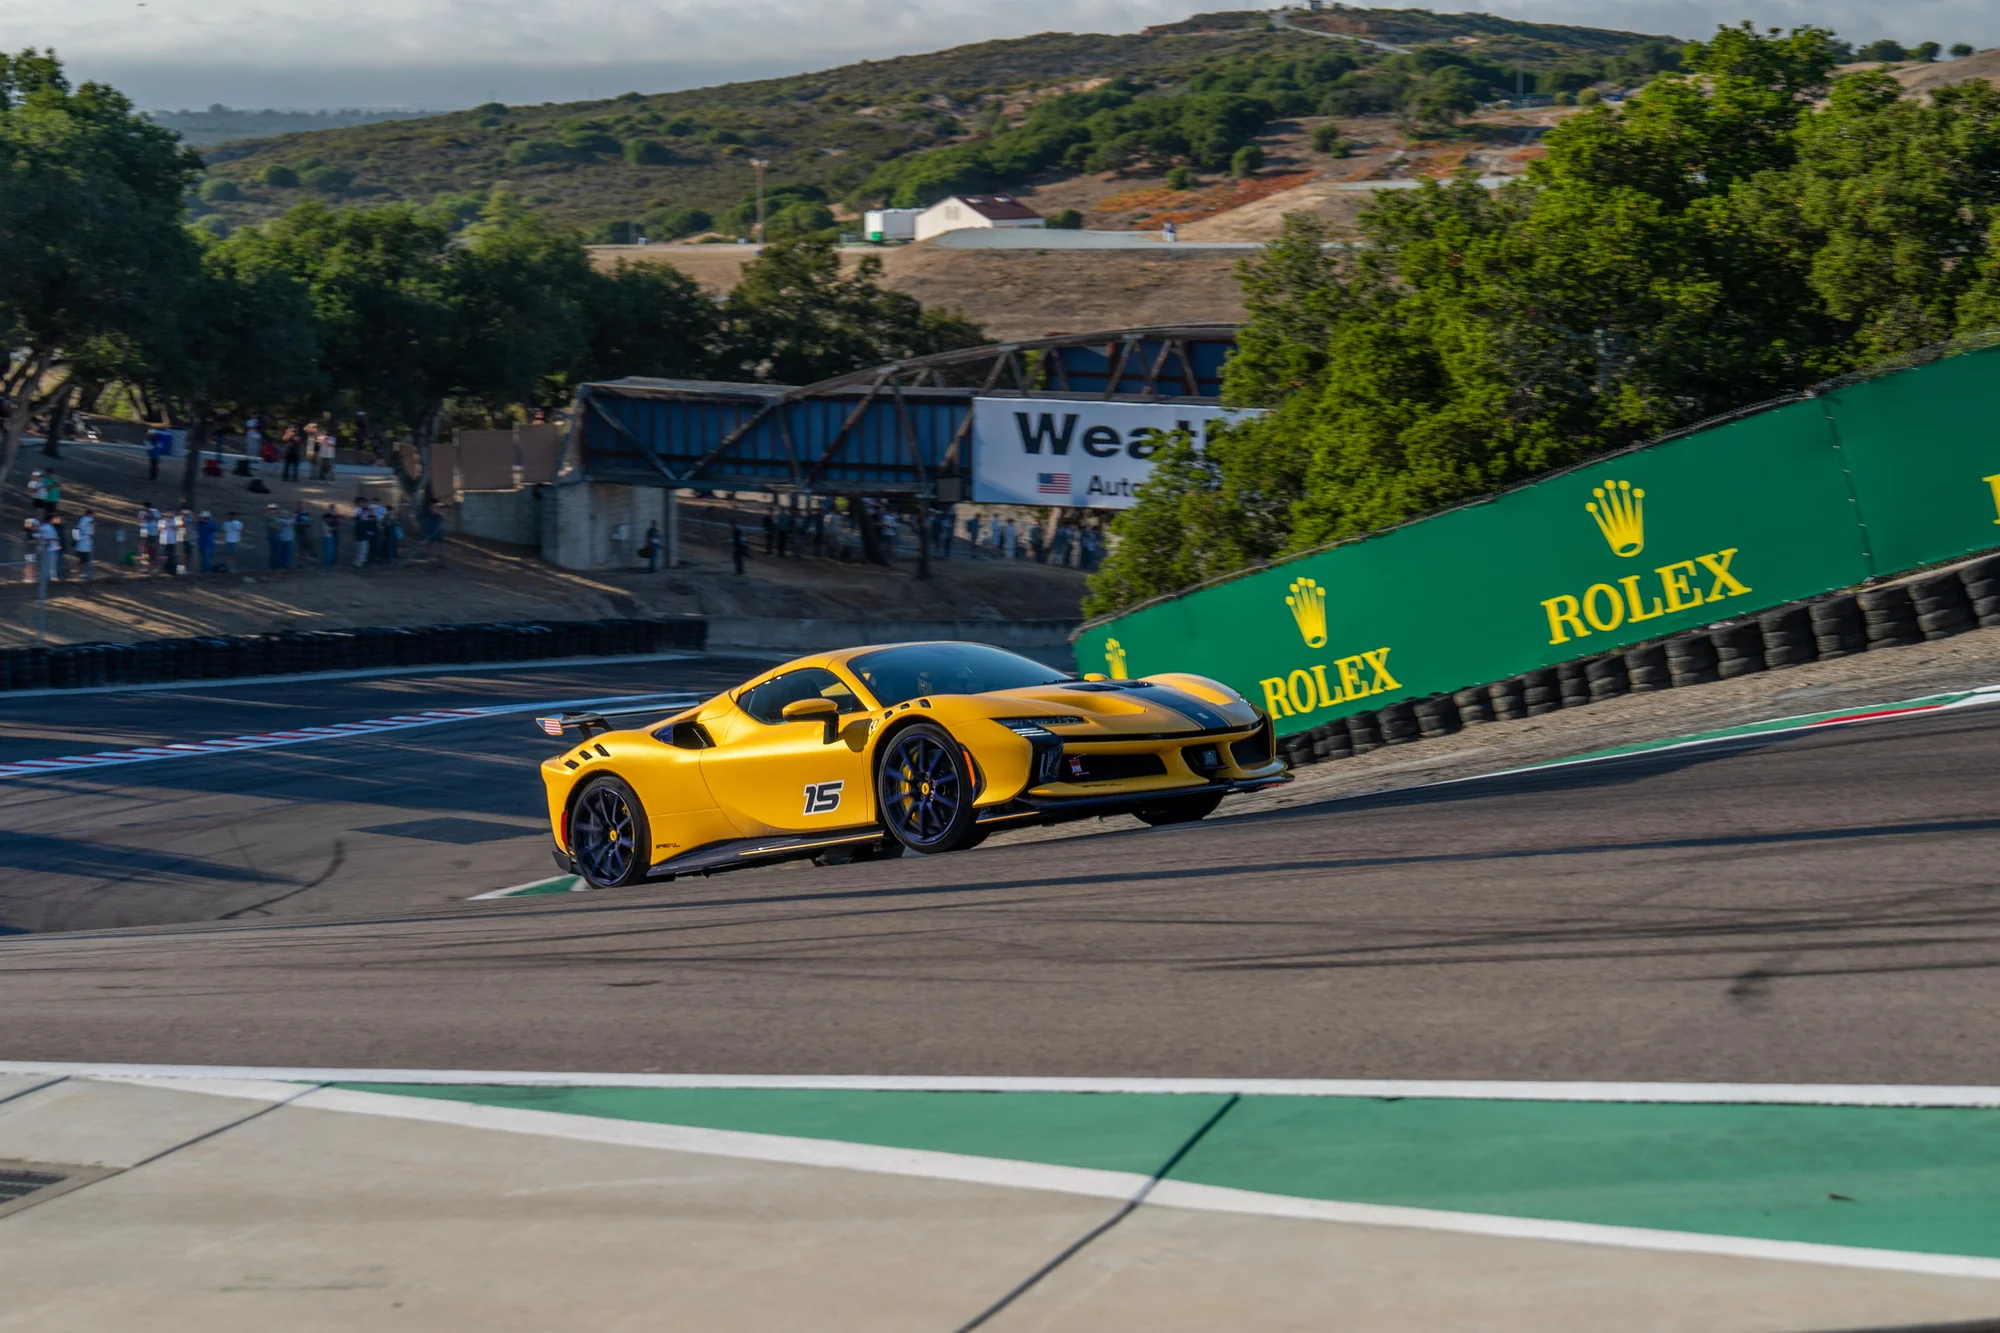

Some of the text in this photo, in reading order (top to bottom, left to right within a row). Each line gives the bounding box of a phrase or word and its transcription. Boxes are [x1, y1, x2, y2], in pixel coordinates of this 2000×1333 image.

[1014, 411, 1211, 460] Weat
[1540, 548, 1752, 645] ROLEX
[1259, 647, 1403, 720] ROLEX
[803, 780, 844, 816] 15
